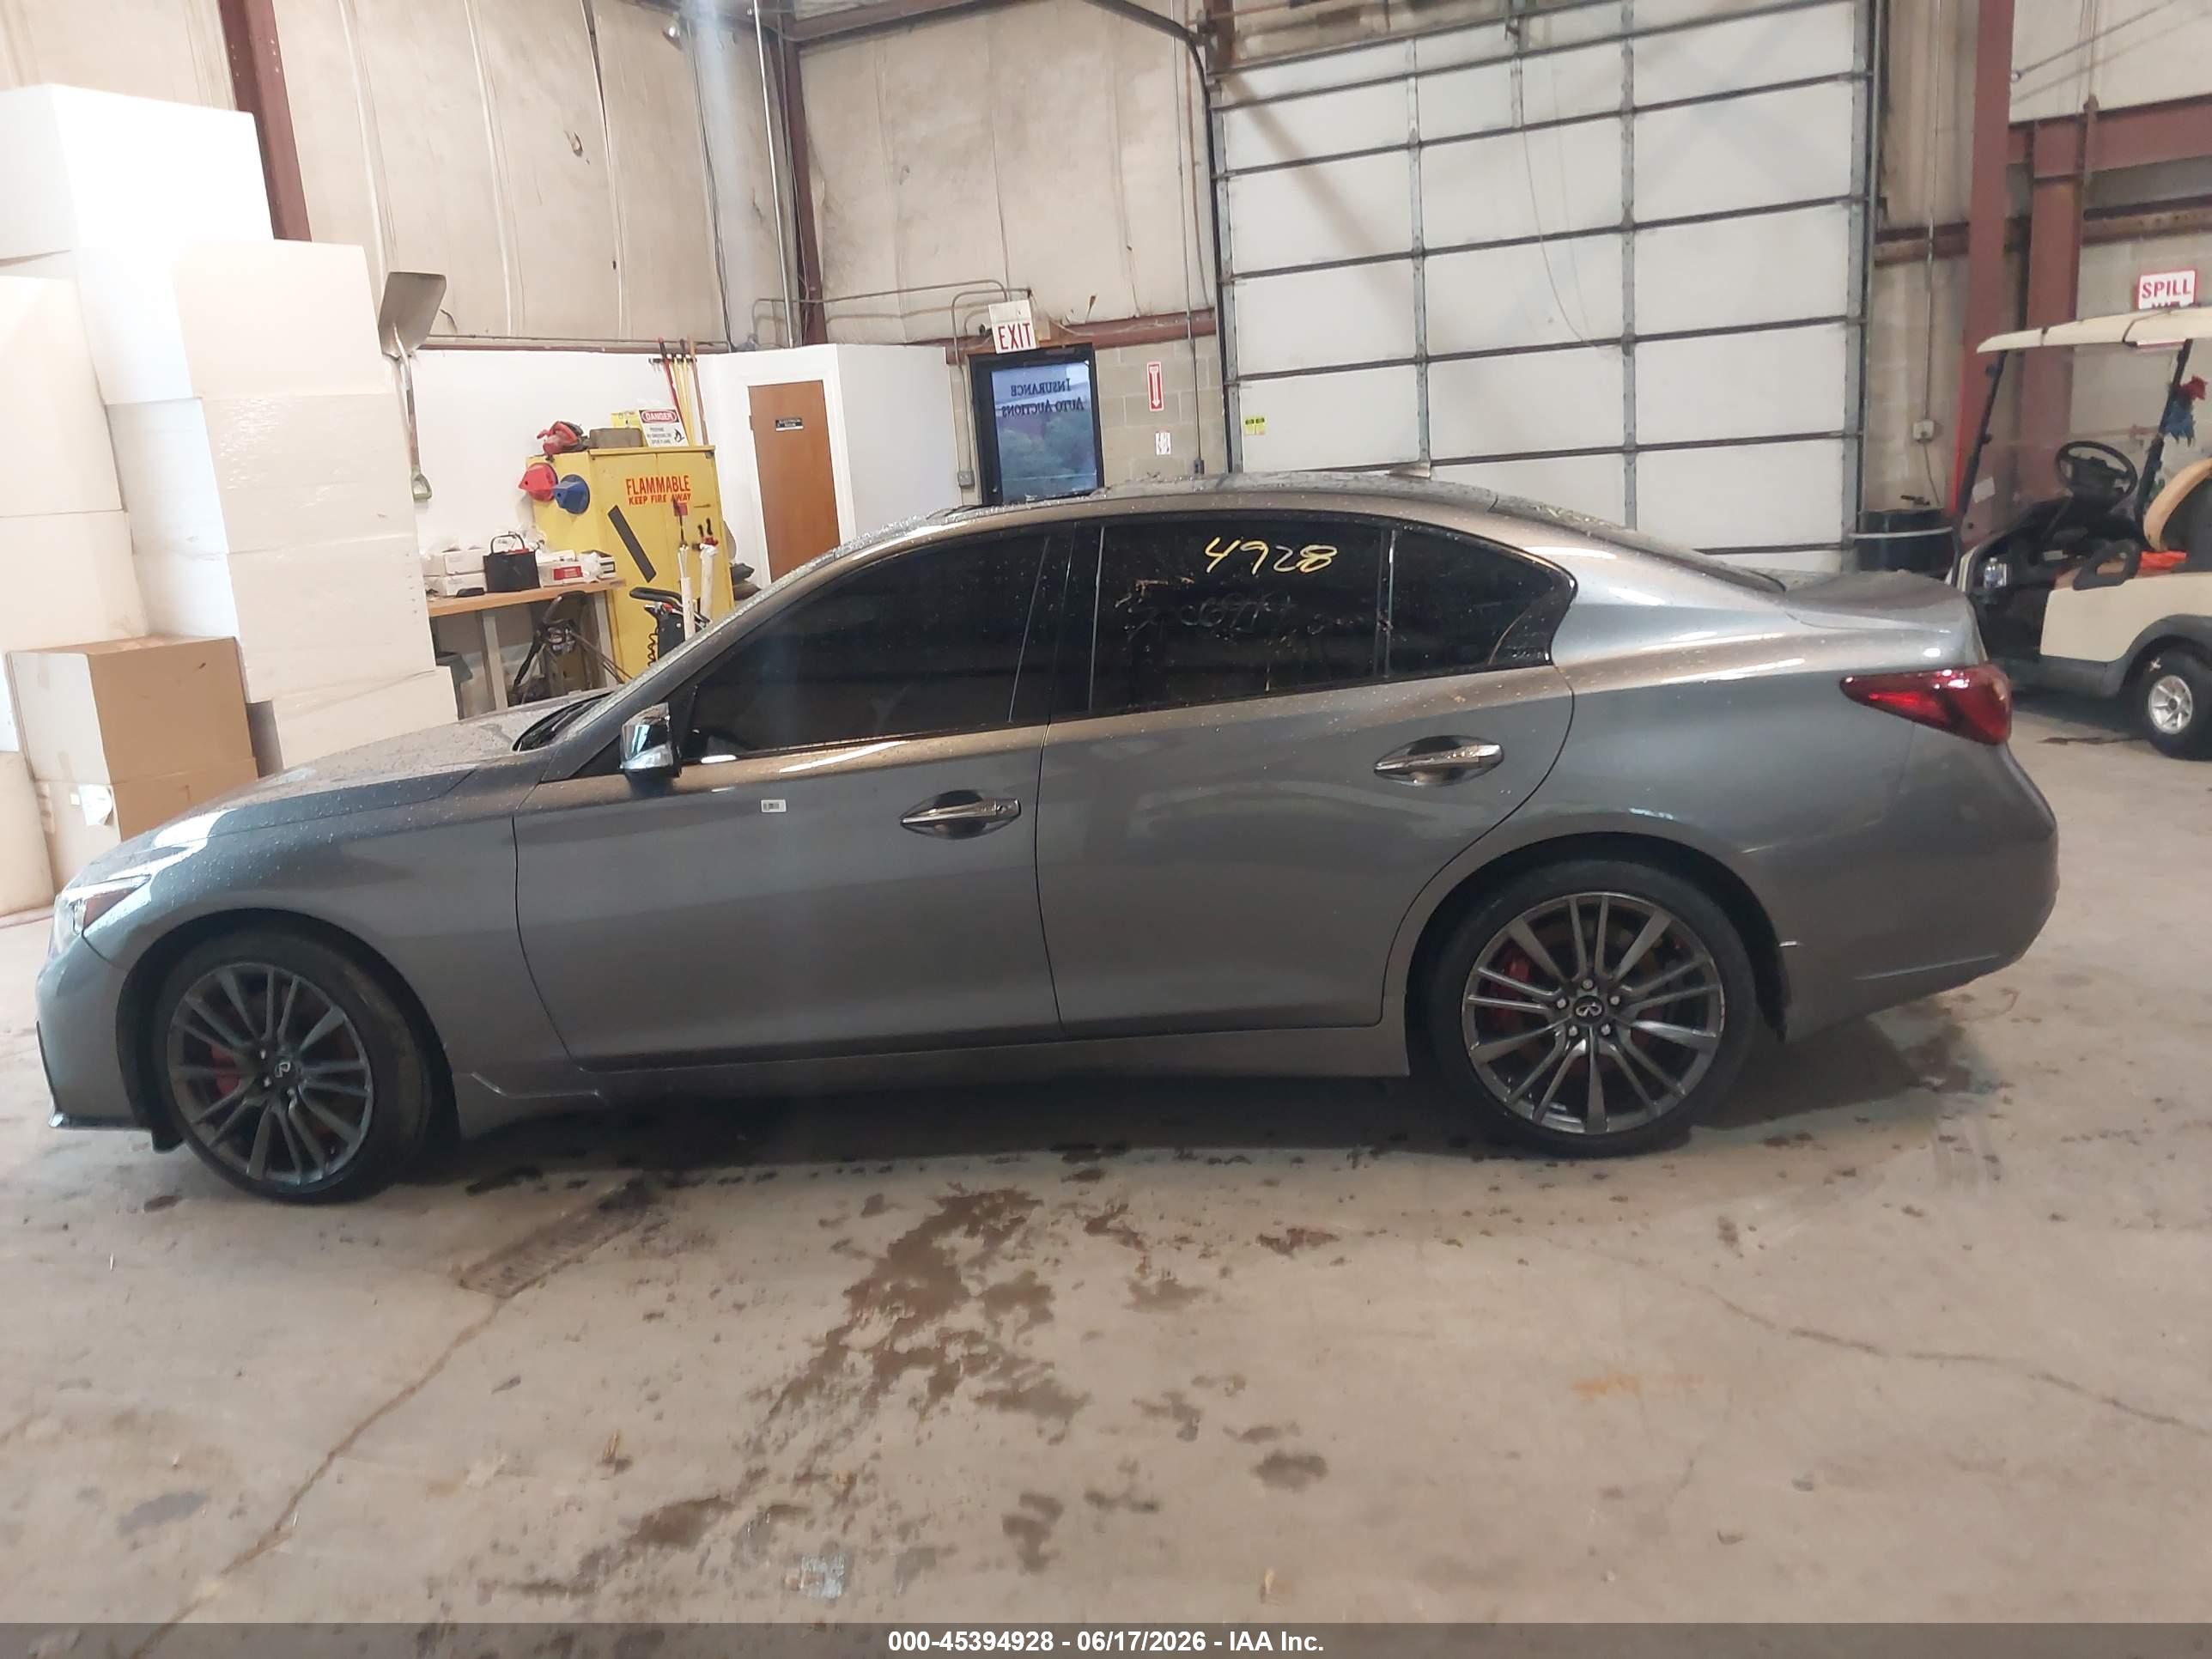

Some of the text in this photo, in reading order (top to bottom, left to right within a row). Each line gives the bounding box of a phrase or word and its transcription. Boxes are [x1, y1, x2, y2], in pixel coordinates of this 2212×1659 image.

[2142, 278, 2192, 299] SPILL
[997, 322, 1031, 350] EXIT
[645, 411, 674, 421] DANGER
[625, 475, 691, 495] FLAMMABLE
[629, 493, 691, 506] KEEP FIRE AWAY
[1204, 536, 1339, 575] 4928
